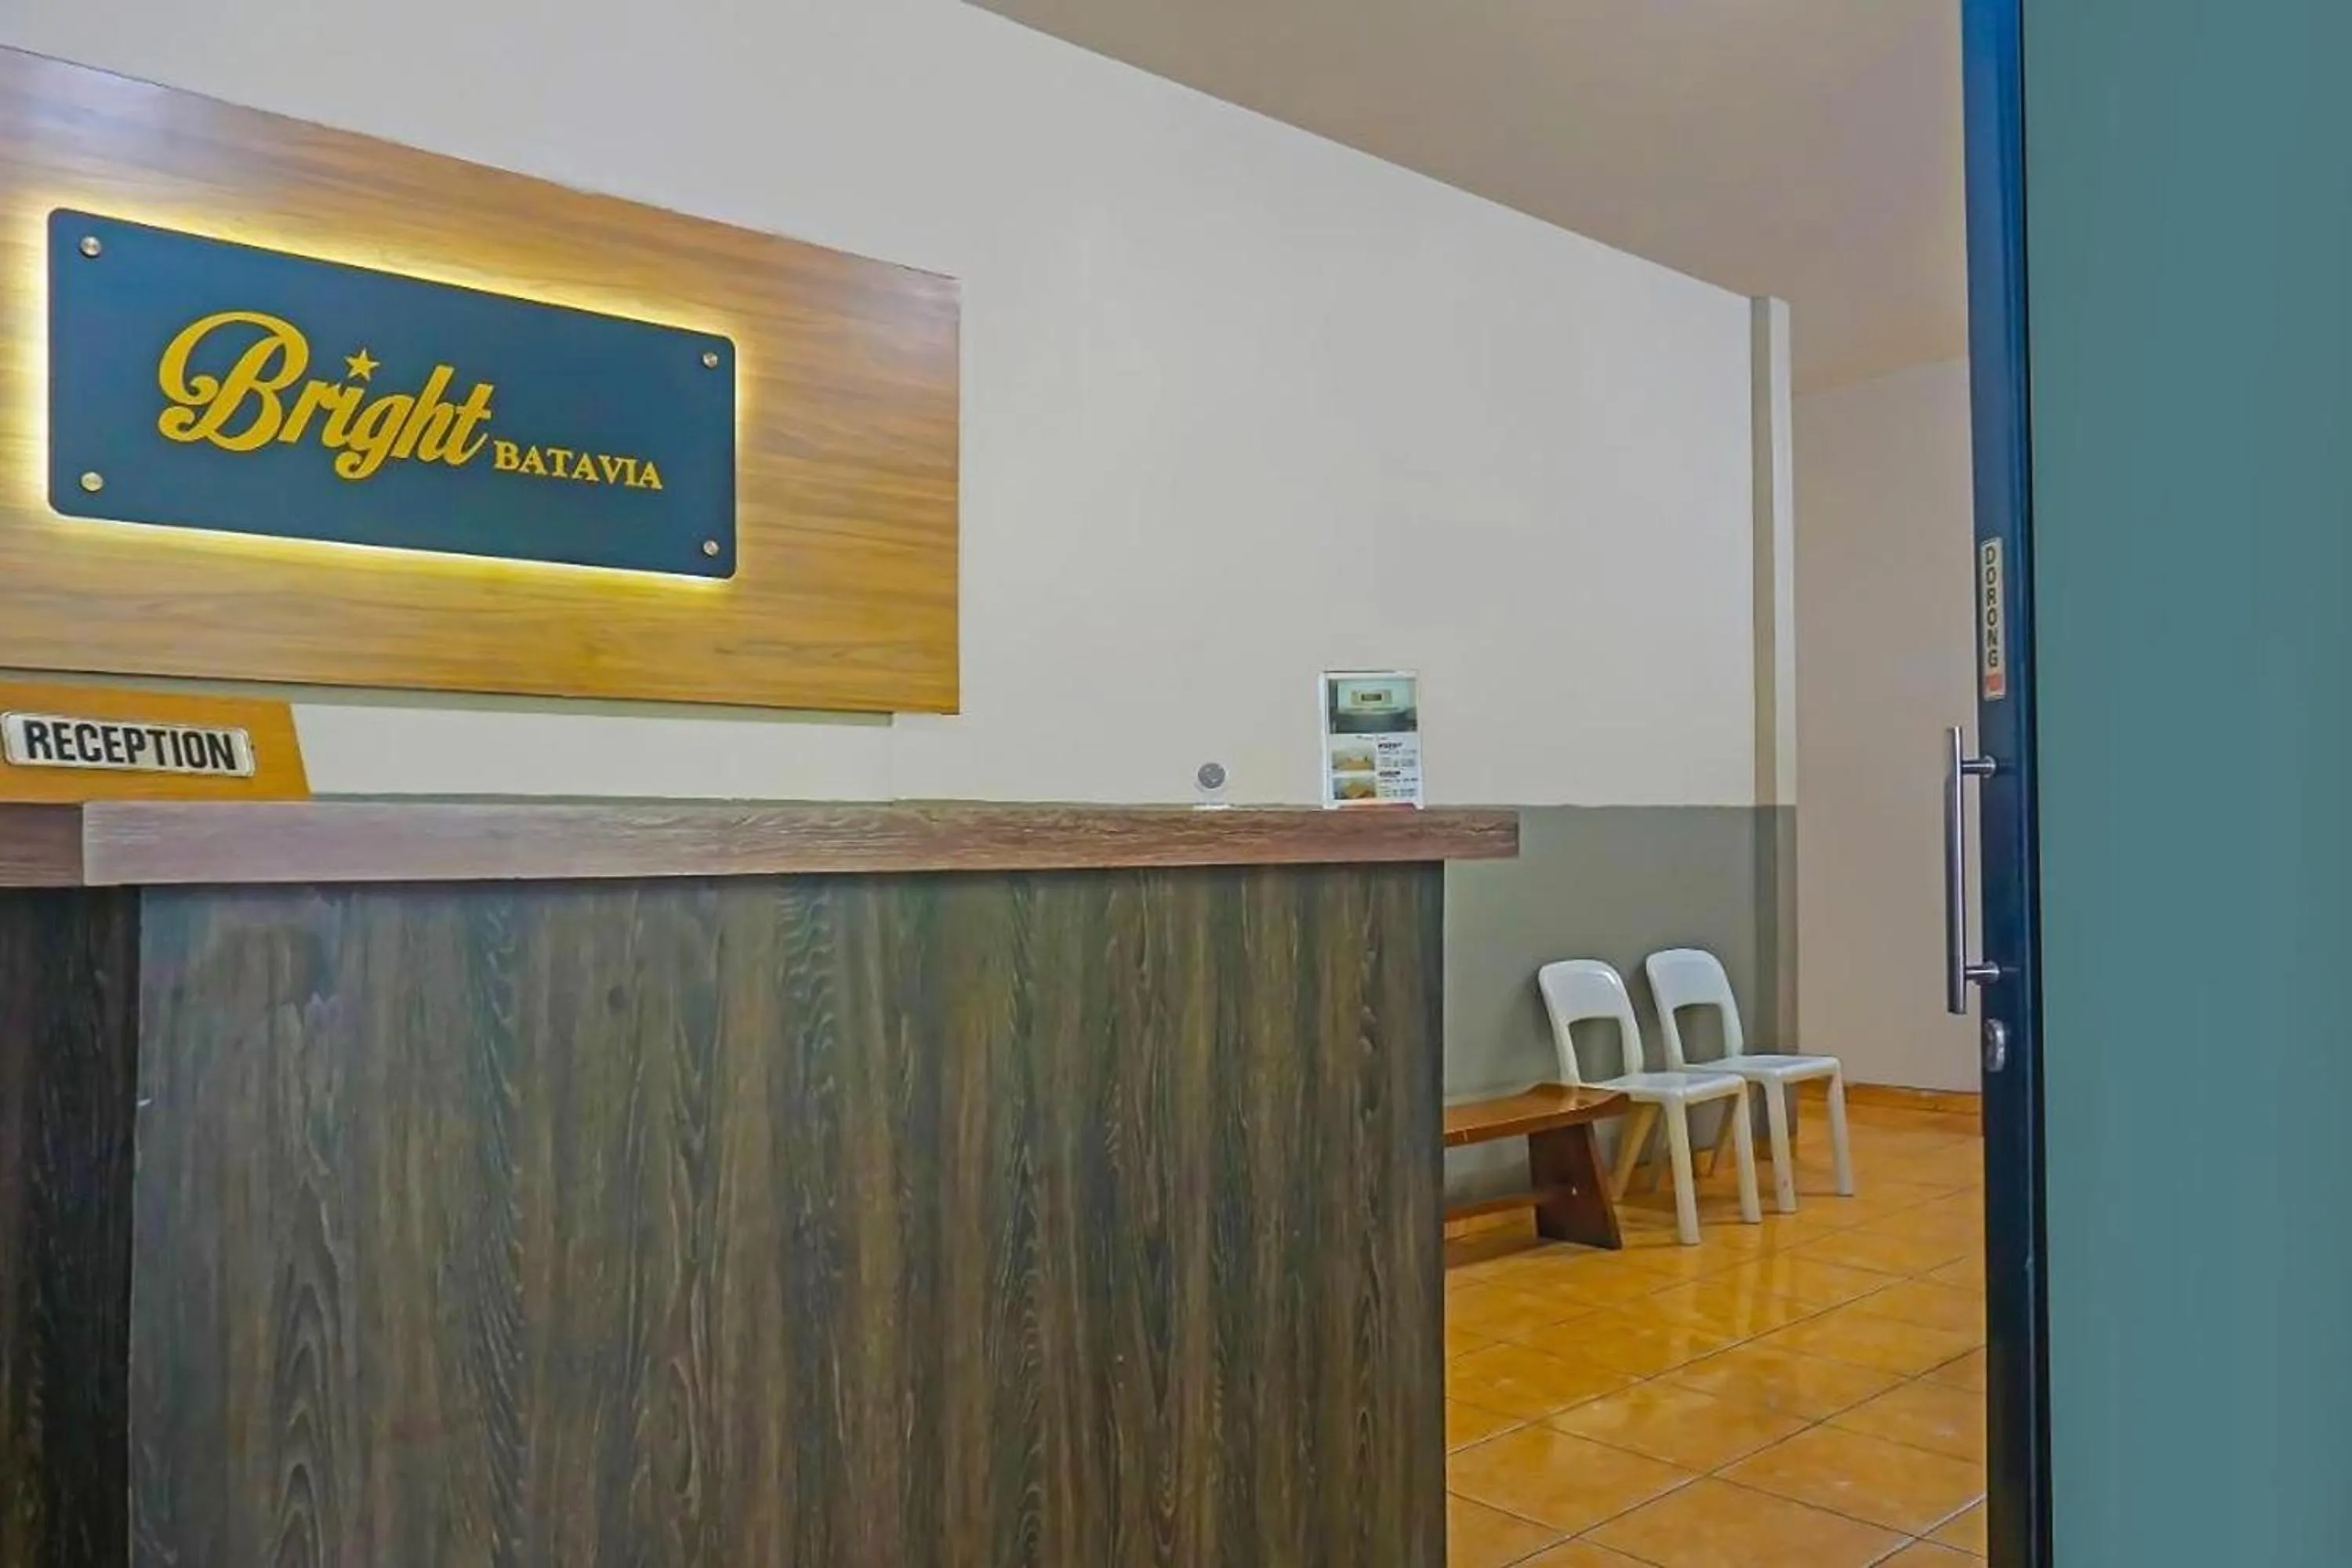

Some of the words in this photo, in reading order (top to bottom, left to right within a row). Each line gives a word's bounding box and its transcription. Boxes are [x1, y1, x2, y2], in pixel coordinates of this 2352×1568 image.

[158, 310, 492, 480] Bright
[493, 440, 663, 491] BATAVIA
[1985, 546, 1999, 668] DORONG
[23, 720, 237, 771] RECEPTION
